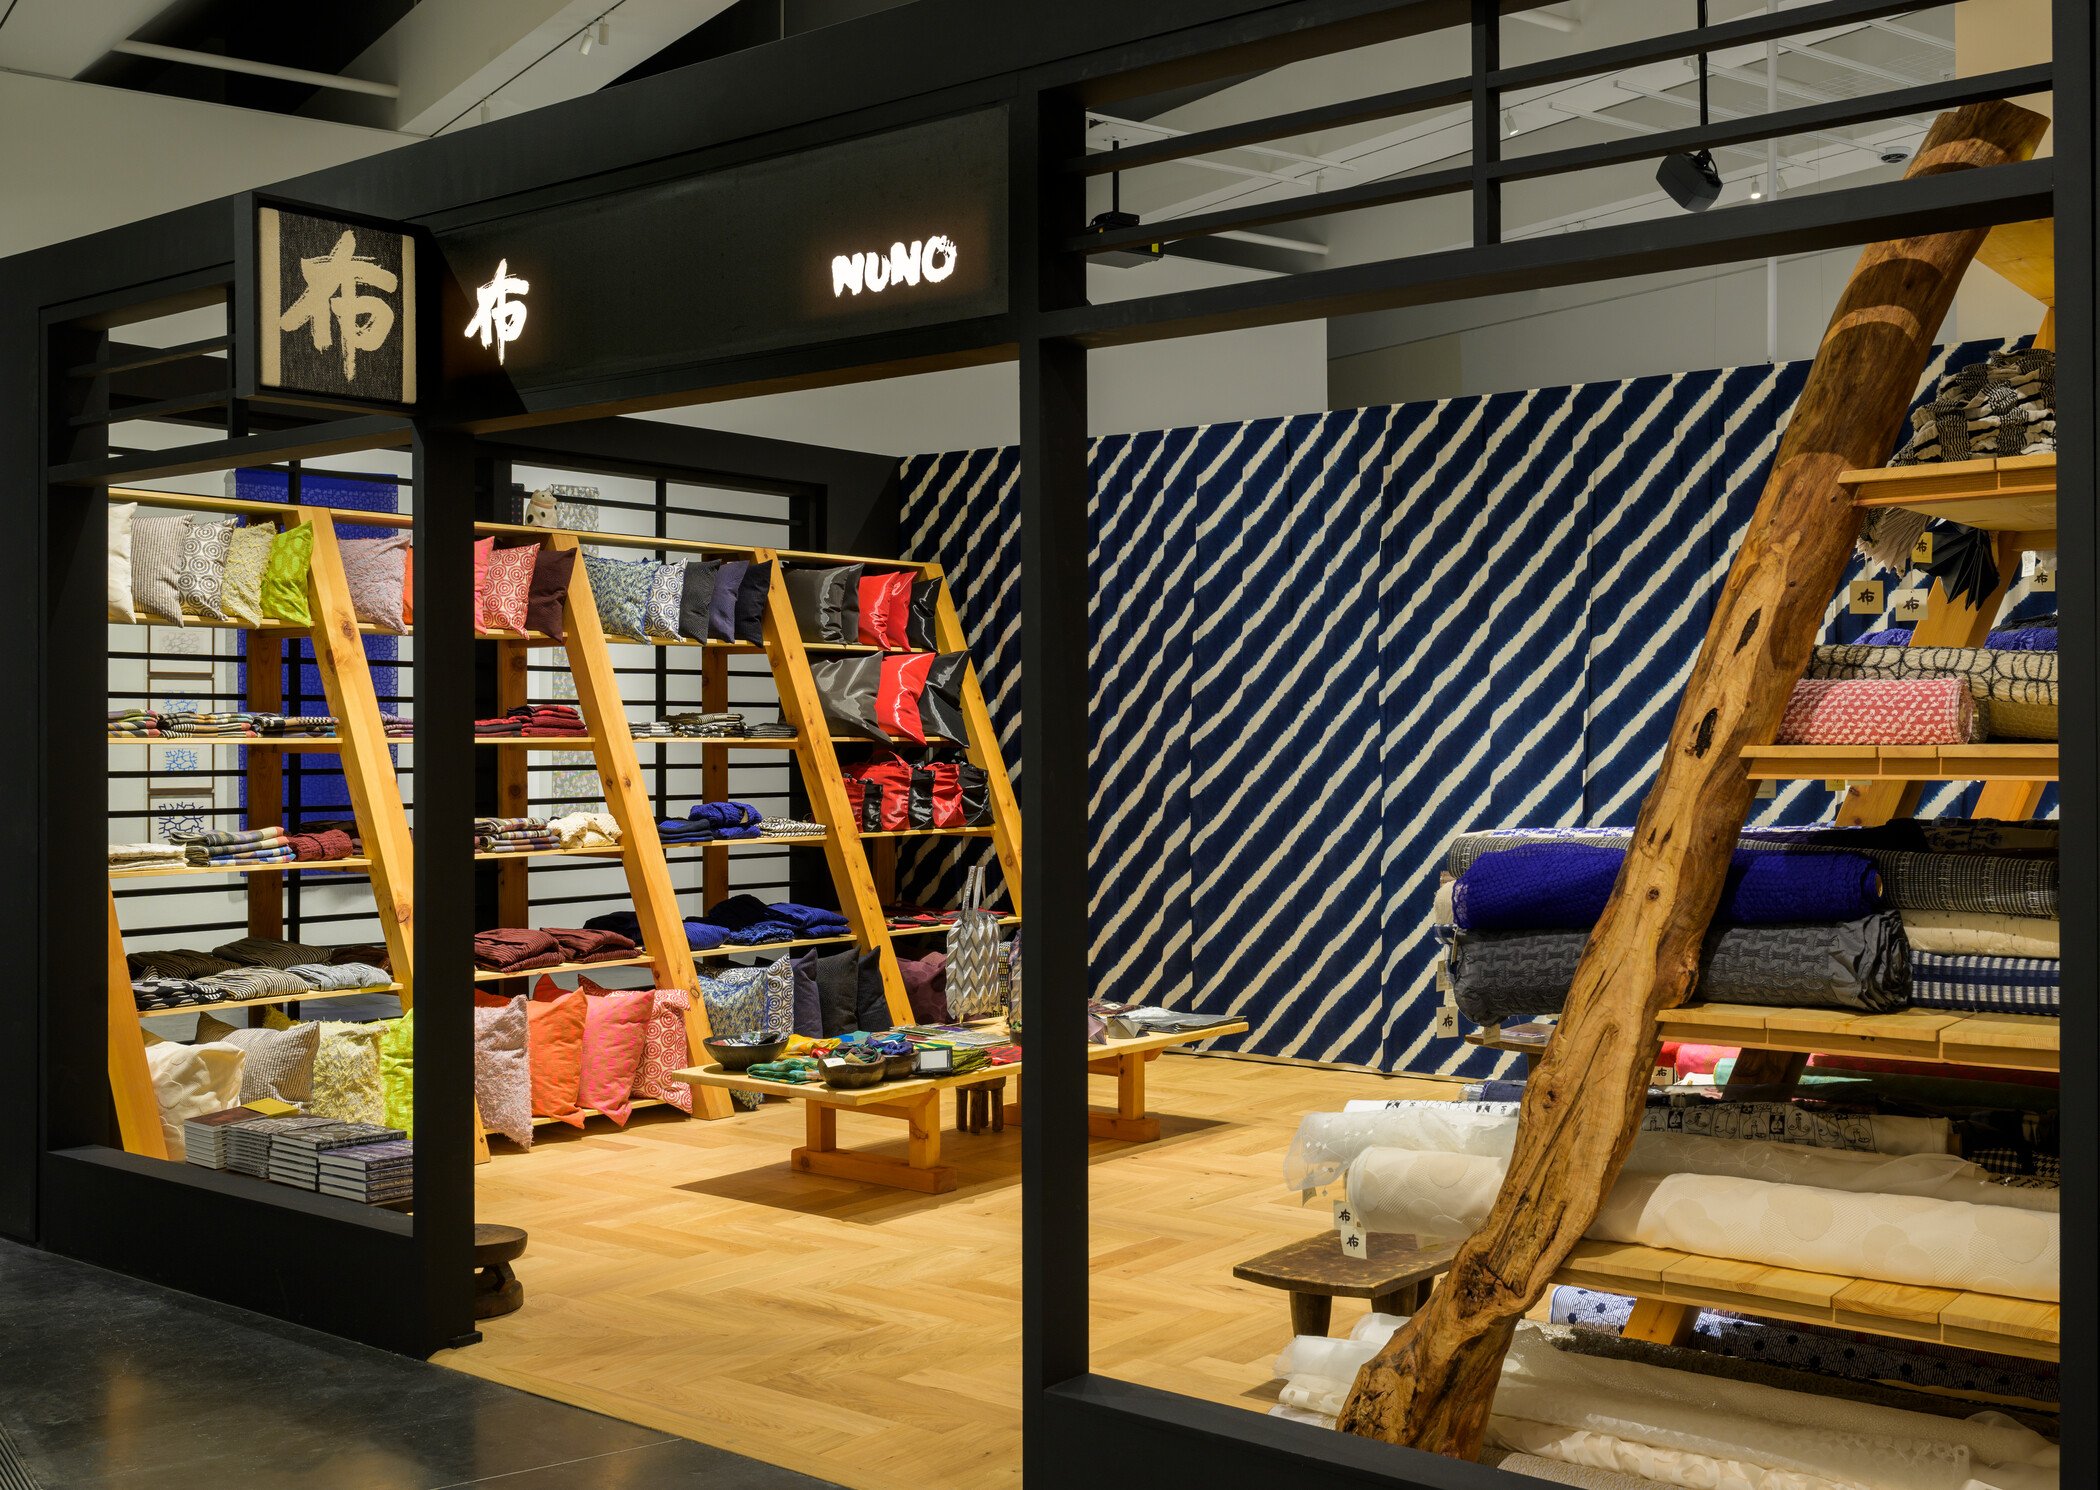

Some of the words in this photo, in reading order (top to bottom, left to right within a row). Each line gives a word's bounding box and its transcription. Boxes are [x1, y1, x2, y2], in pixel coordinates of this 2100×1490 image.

[832, 234, 958, 298] NUNO
[280, 230, 398, 383] 布
[465, 259, 530, 365] 布
[1916, 539, 1927, 554] 布
[2034, 572, 2048, 586] 布
[1857, 588, 1875, 606] 布
[1903, 597, 1920, 613] 布
[1442, 1014, 1453, 1030] 布
[1656, 1067, 1667, 1077] 布
[1338, 1208, 1351, 1224] 布
[1346, 1234, 1360, 1250] 布
